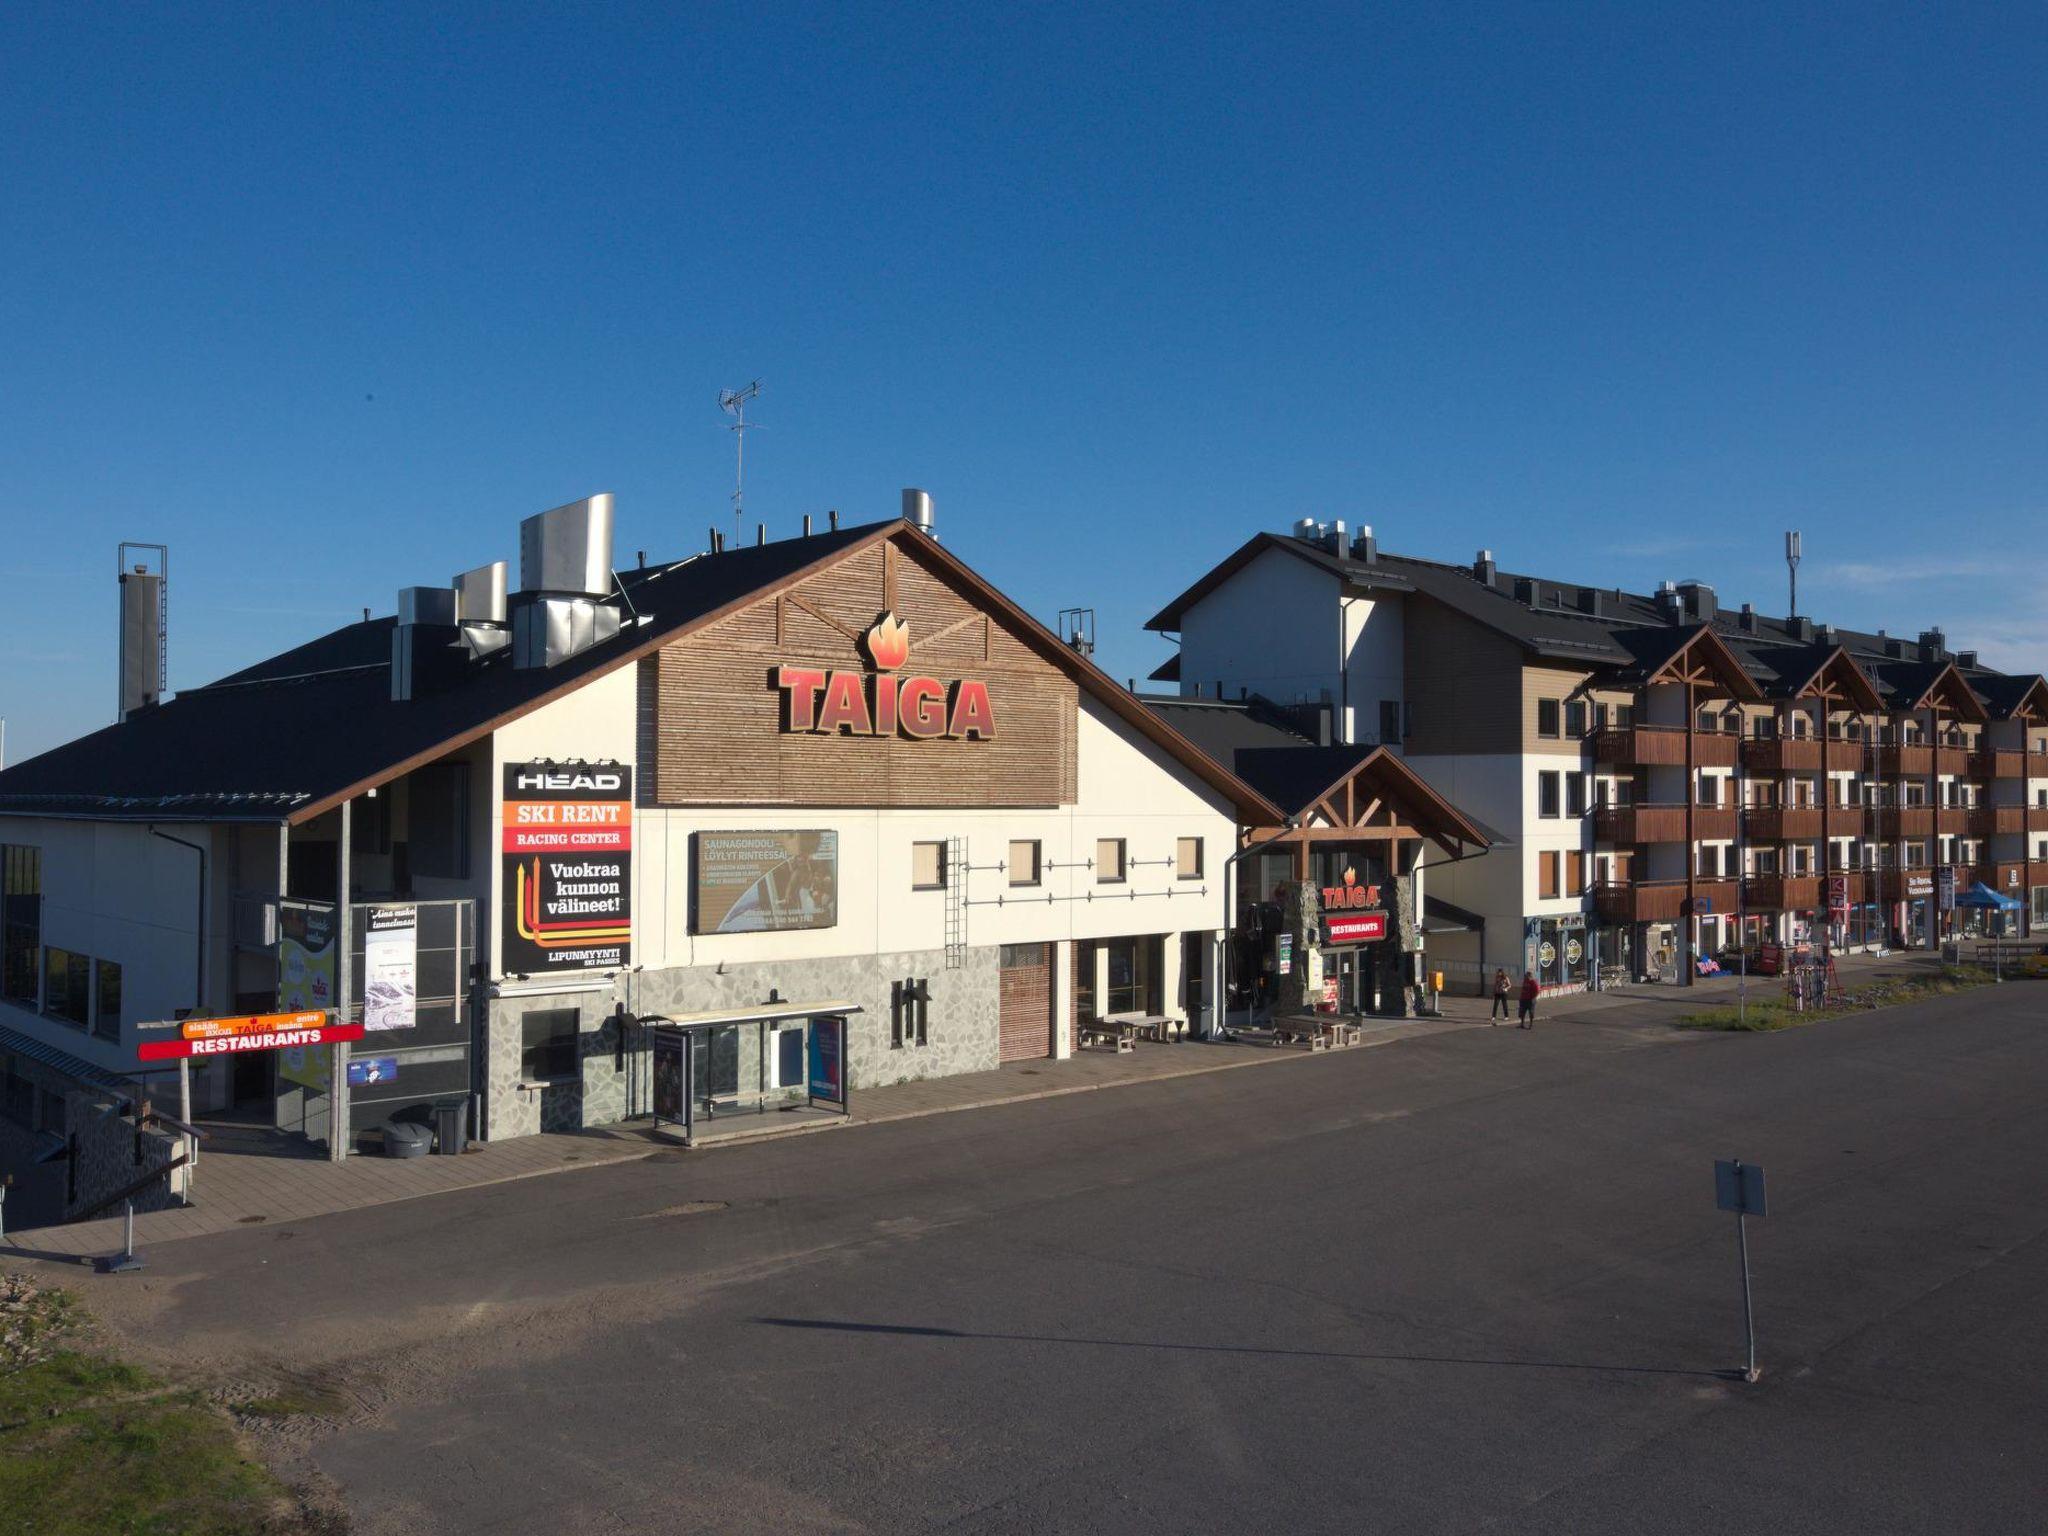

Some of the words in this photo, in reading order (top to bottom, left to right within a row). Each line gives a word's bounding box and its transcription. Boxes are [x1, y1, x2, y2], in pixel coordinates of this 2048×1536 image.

[777, 665, 998, 740] TAIGA
[517, 774, 621, 790] HEAD
[517, 805, 556, 823] SKI
[562, 805, 620, 823] RENT
[517, 834, 568, 845] RACING
[571, 833, 621, 844] CENTER
[550, 863, 620, 878] Vuokraa
[556, 881, 620, 896] kunnon
[1322, 886, 1379, 910] TAIGA
[547, 898, 620, 914] välineet!
[1331, 922, 1379, 935] RESTAURANTS
[548, 949, 621, 962] LIPUNMYYNTI
[596, 958, 620, 966] PASSES
[236, 1023, 274, 1035] TAIGA
[191, 1030, 322, 1054] RESTAURANTS
